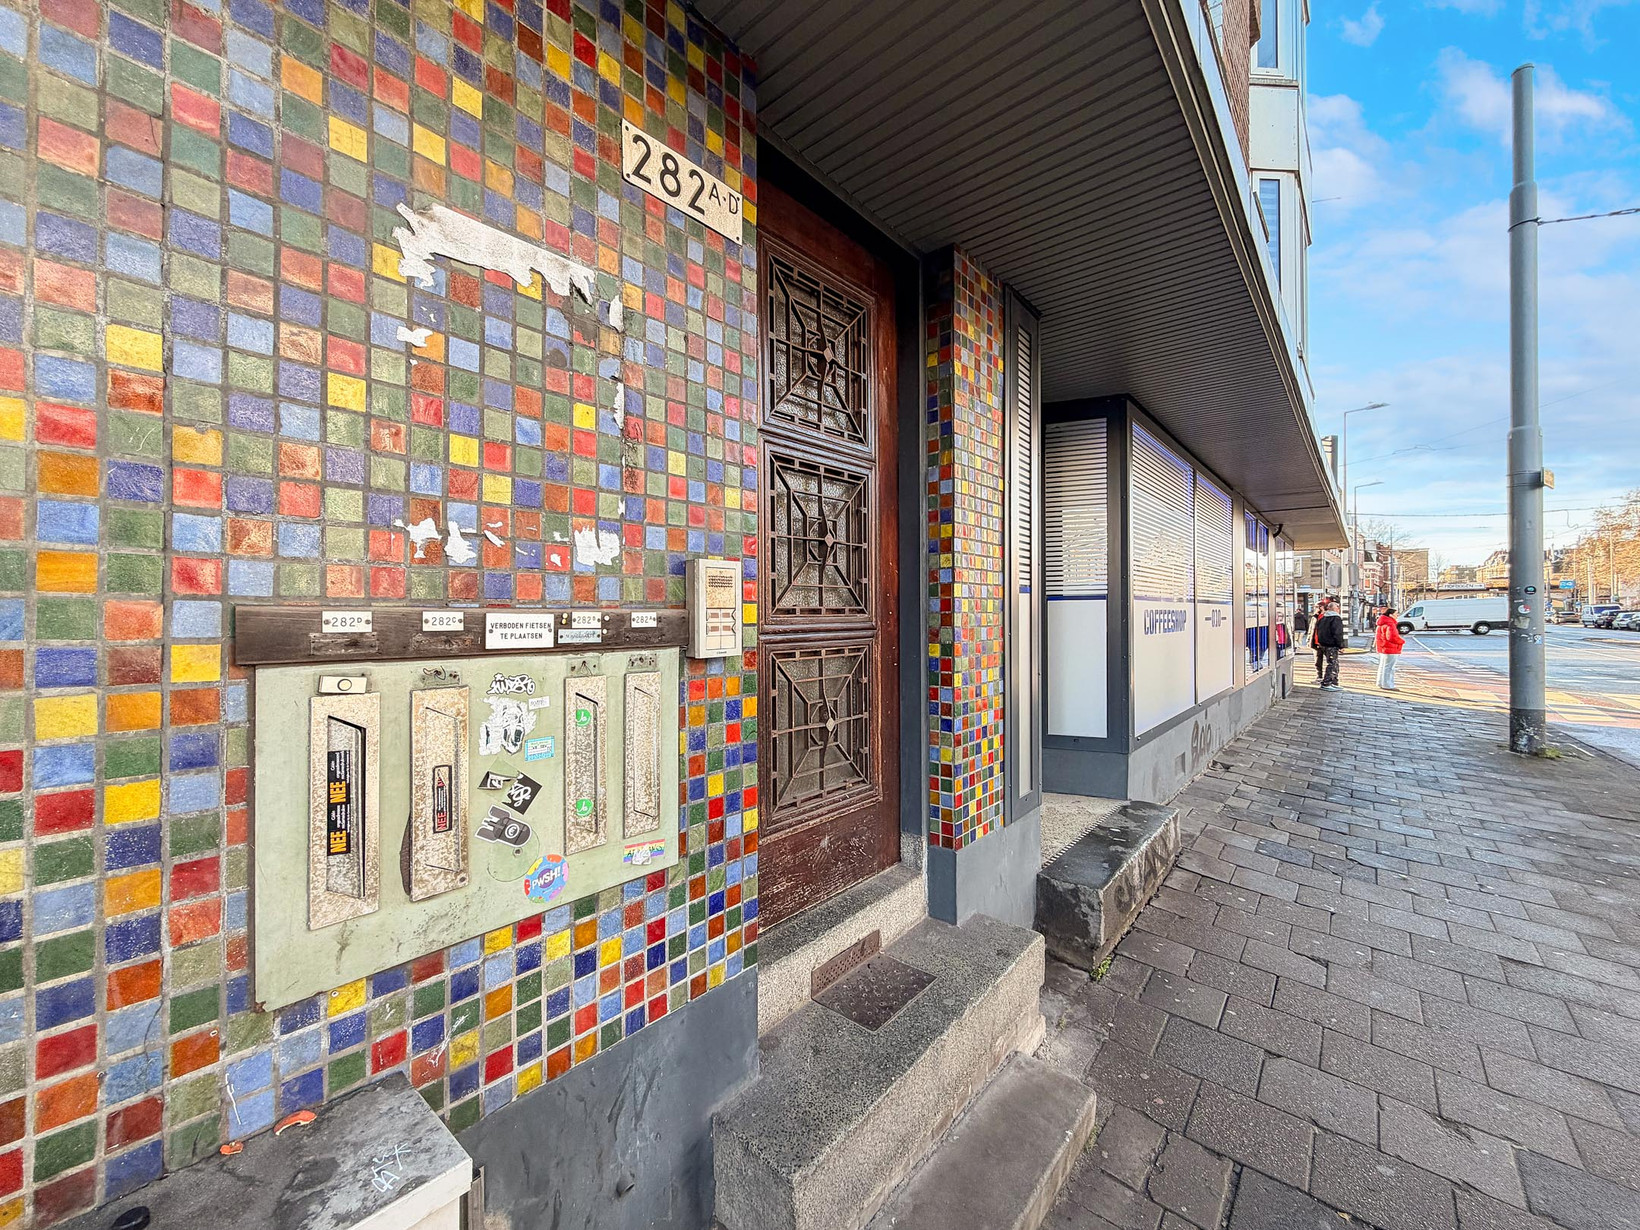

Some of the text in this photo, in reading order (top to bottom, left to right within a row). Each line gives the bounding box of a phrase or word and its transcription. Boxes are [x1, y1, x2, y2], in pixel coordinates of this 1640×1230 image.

[431, 616, 457, 626] 282C
[1144, 609, 1187, 635] COFFEESHOP
[500, 632, 543, 640] TE PLAATSEN
[330, 781, 346, 803] NEE
[436, 811, 448, 831] NEE
[330, 831, 347, 853] NEE
[531, 866, 561, 890] PWSH!
